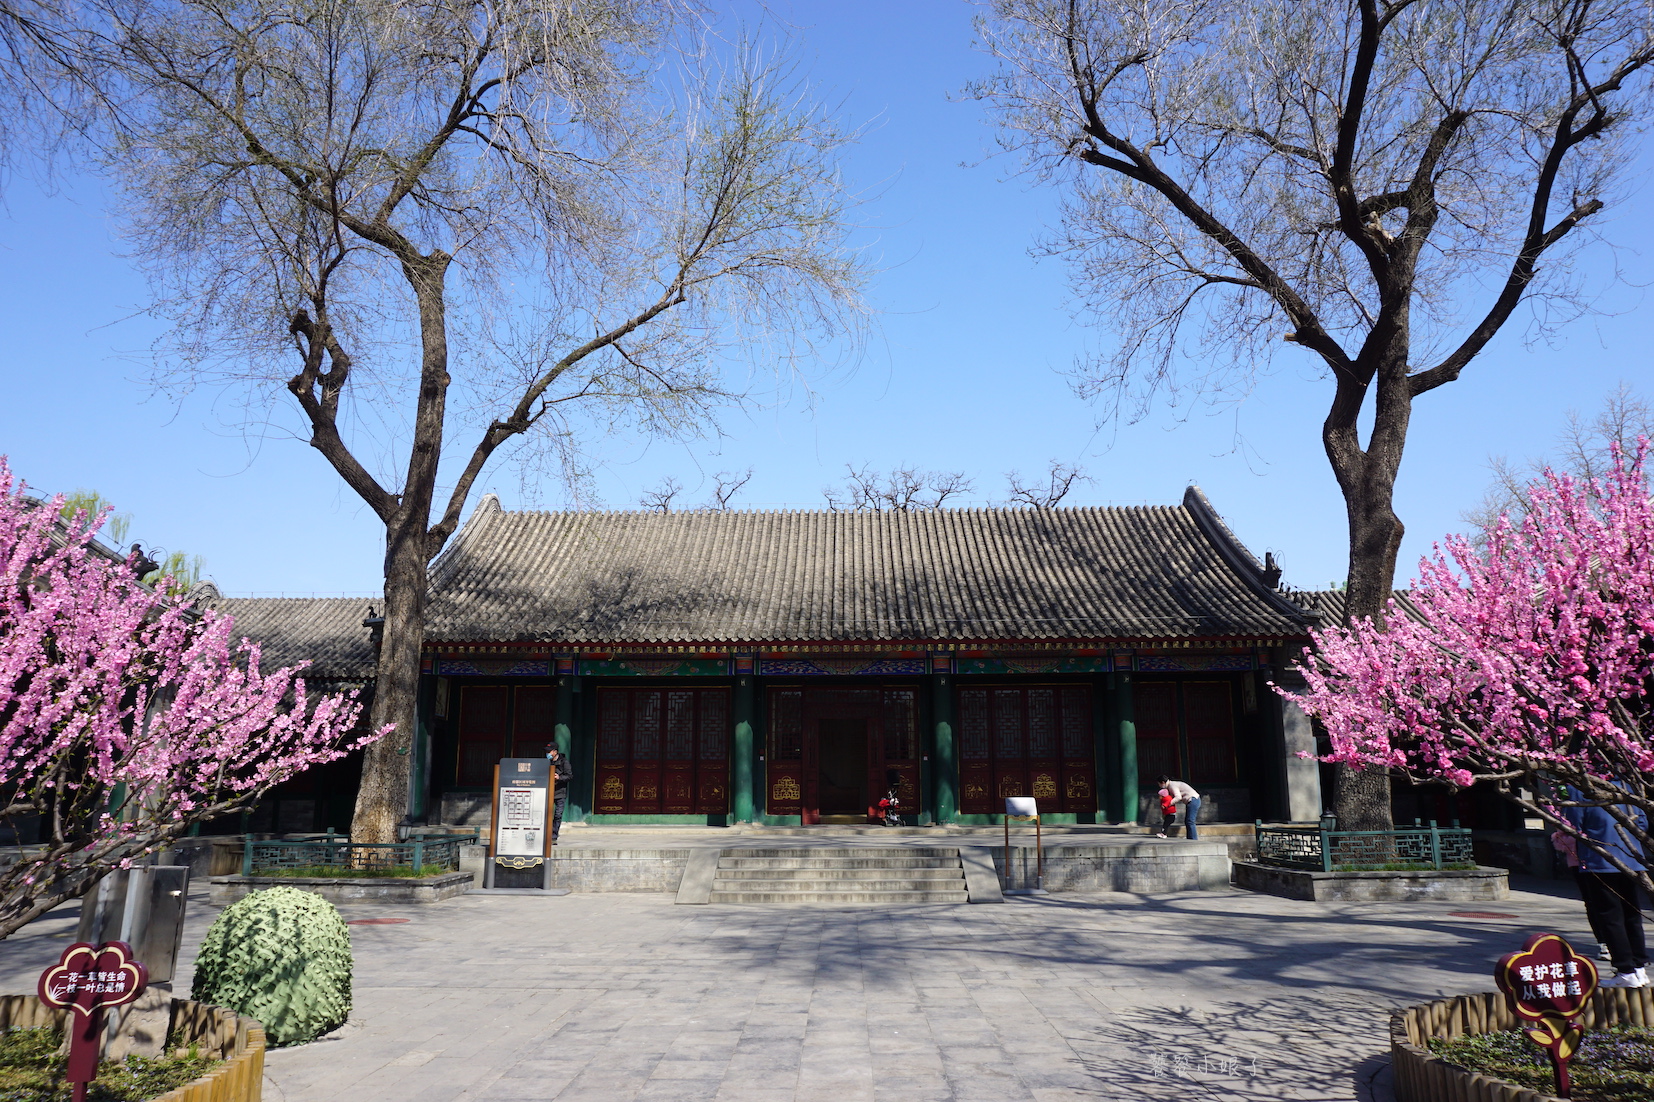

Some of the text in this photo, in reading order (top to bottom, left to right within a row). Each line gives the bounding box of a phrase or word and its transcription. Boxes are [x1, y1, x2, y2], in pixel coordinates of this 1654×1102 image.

[58, 971, 127, 983] 一花一草皆生命
[1519, 961, 1580, 982] 爱护花草
[57, 983, 125, 994] 一枝一叶总是情
[1522, 980, 1582, 1001] 从我做起
